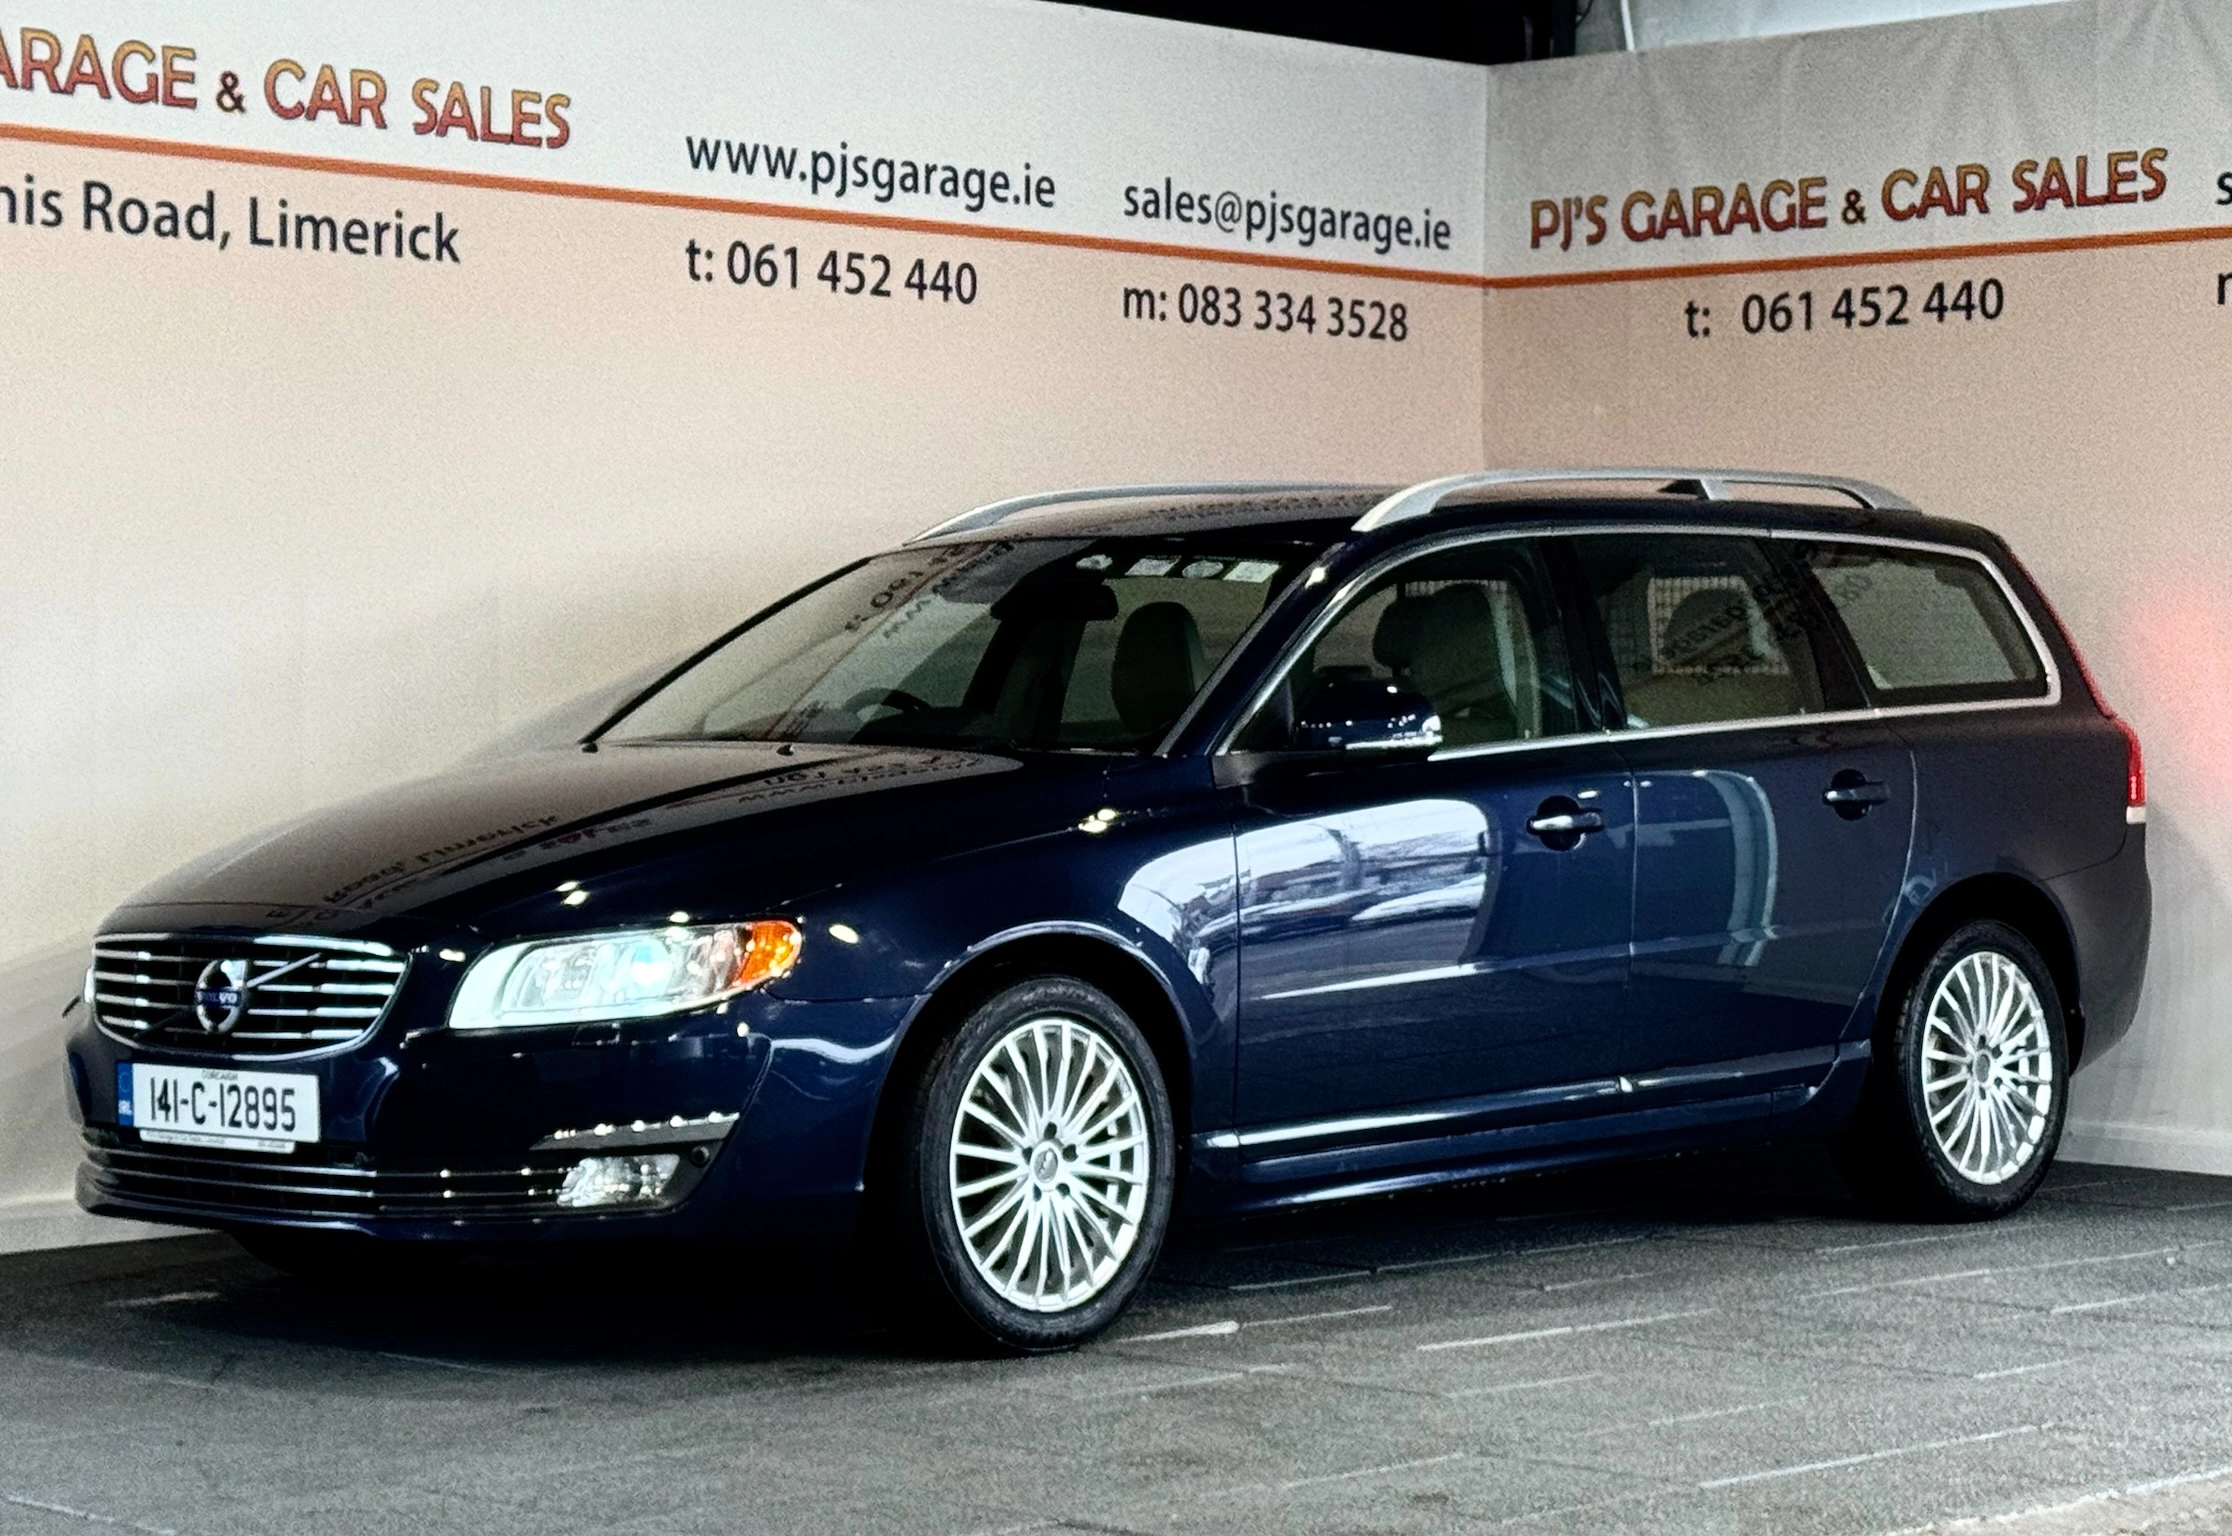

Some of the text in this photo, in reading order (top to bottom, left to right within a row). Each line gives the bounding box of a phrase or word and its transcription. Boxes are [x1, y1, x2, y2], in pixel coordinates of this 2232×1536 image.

[216, 71, 246, 113] &
[264, 59, 387, 129] CAR
[412, 78, 571, 149] SALES
[685, 136, 1056, 210] www.pjsgarage.ie
[1531, 195, 1607, 251] PJ'S
[1621, 177, 1827, 242] GARAGE
[1842, 189, 1866, 225] &
[1882, 164, 1990, 221] CAR
[2012, 148, 2168, 213] SALES
[83, 181, 230, 250] Road,
[250, 197, 460, 263] Limerick
[1123, 177, 1452, 253] sales@pjsgarage.ie
[686, 239, 977, 304] t: 061 452 440
[1685, 278, 2003, 337] t: 061 452 440
[1124, 284, 1407, 341] m: 083 334 3528
[150, 1077, 296, 1133] 141-C-12895
